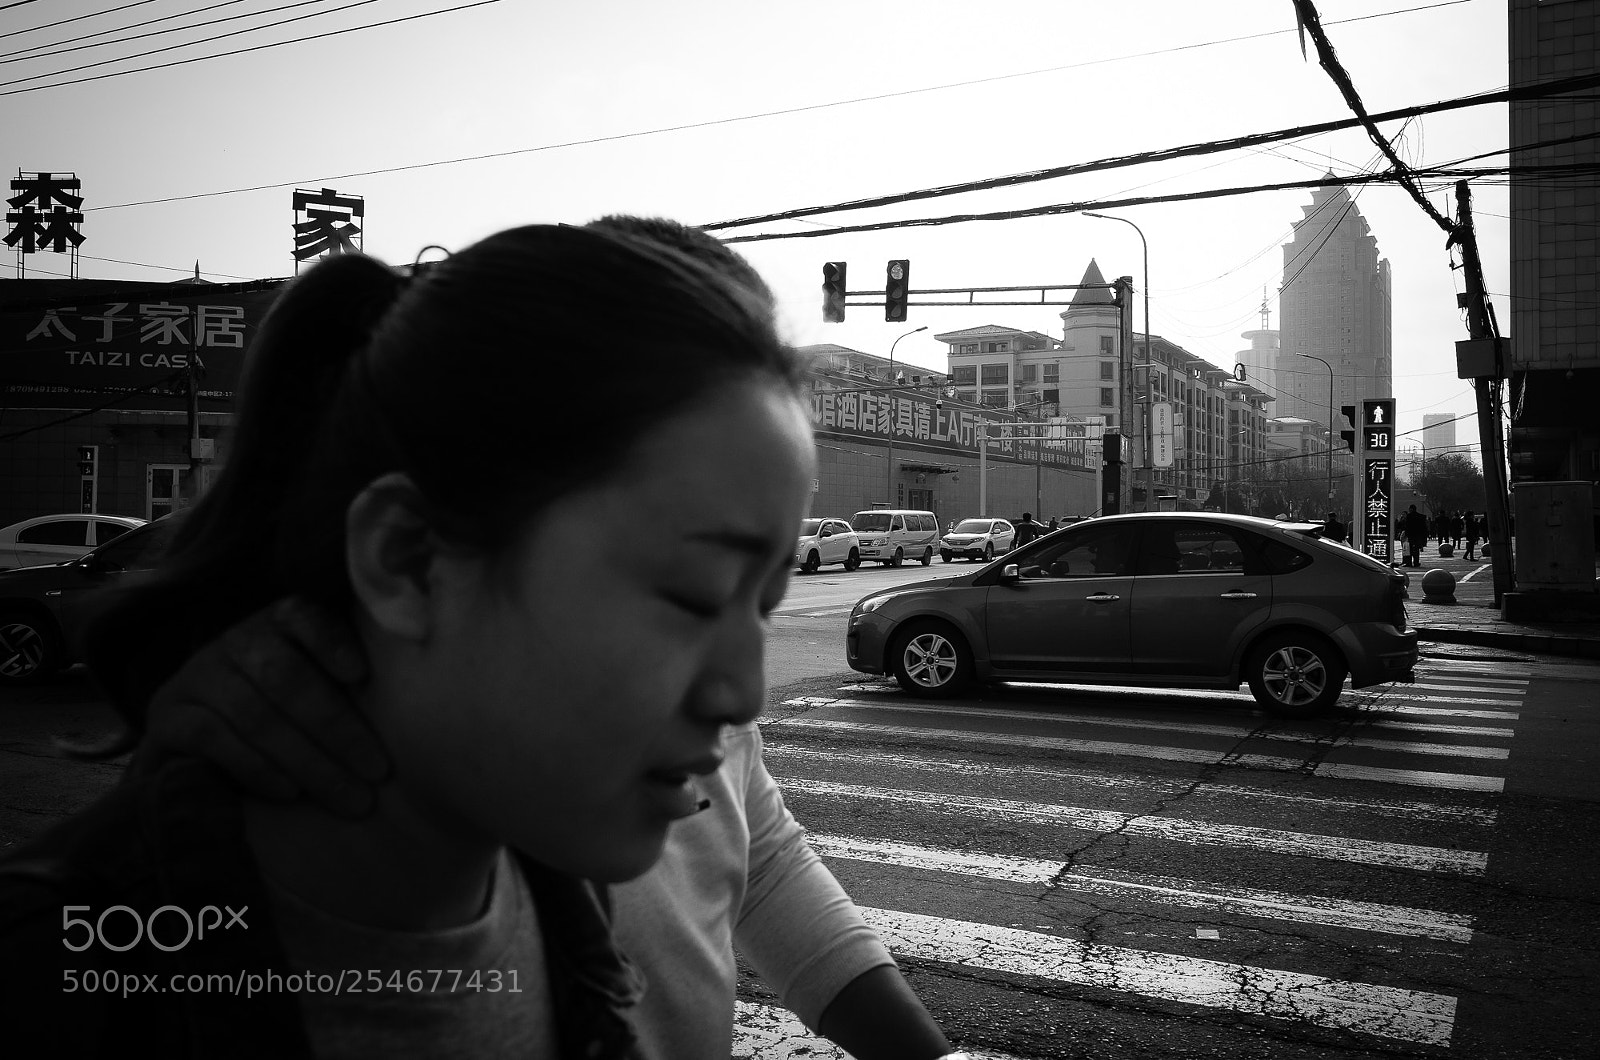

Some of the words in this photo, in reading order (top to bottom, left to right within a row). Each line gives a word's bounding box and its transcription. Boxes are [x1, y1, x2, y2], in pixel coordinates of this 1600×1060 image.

[2, 172, 87, 253] 森
[290, 187, 365, 261] 家
[25, 301, 247, 349] 太子家居
[64, 350, 130, 367] TAIZI
[1370, 433, 1388, 448] 30
[1367, 461, 1389, 562] 行人禁止通
